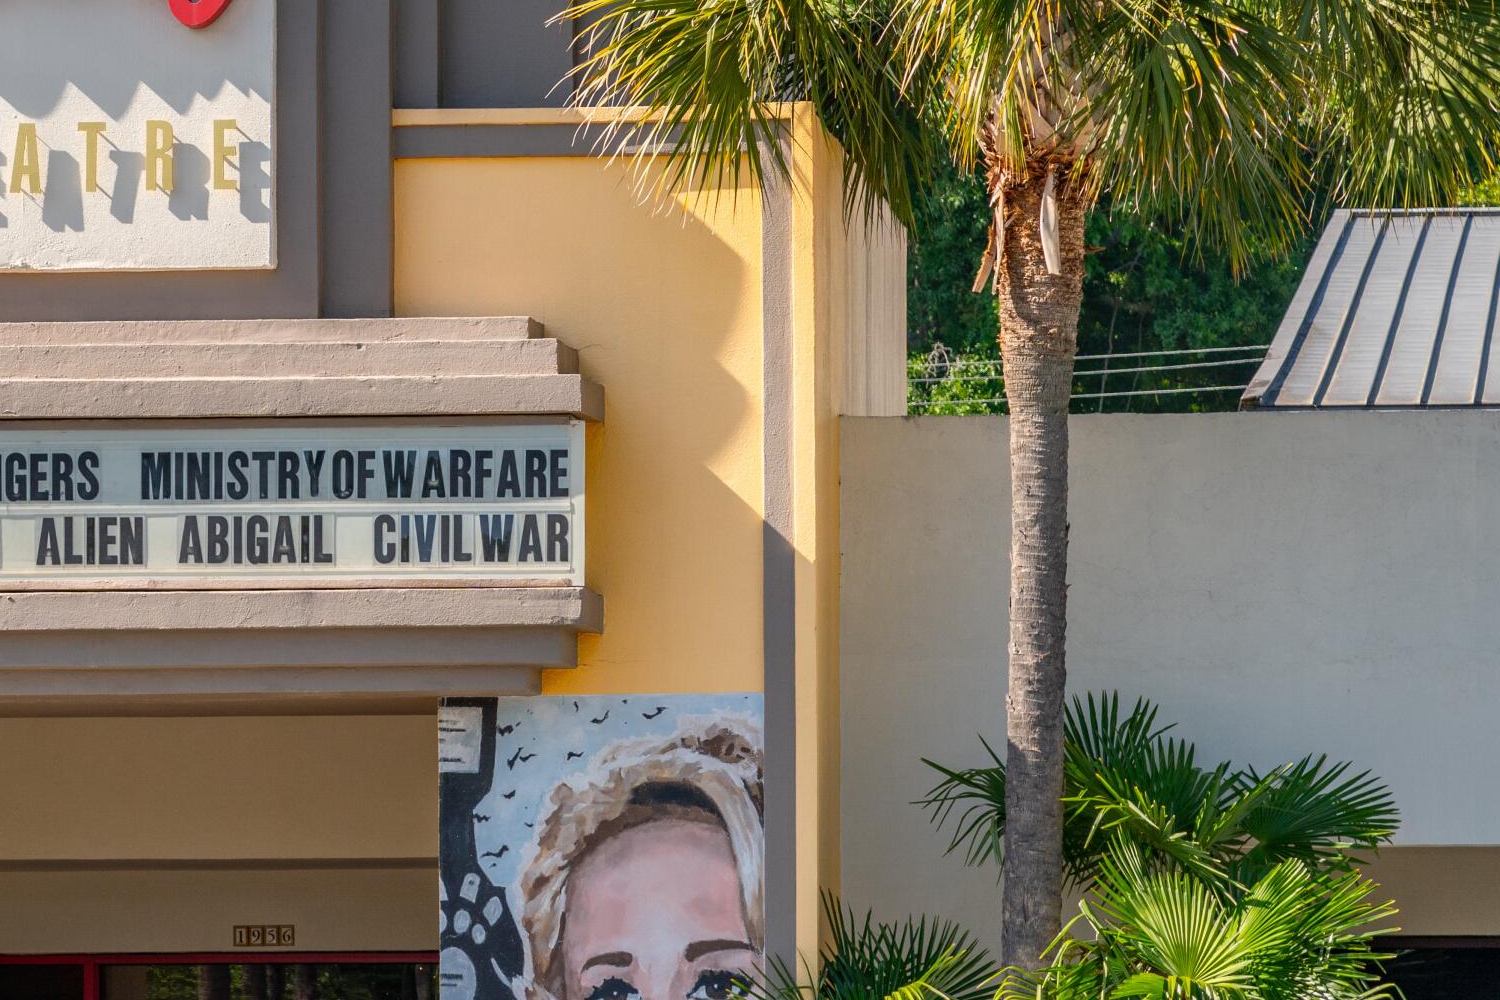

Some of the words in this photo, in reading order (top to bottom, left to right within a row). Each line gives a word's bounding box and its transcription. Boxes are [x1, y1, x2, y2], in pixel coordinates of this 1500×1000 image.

[141, 450, 327, 500] MINISTRY
[332, 450, 376, 498] OF
[382, 450, 570, 498] WARFARE
[36, 516, 145, 566] ALIEN
[179, 515, 333, 564] ABIGAIL
[373, 514, 472, 564] CIVIL
[479, 513, 569, 563] WAR
[236, 929, 292, 944] 1956
